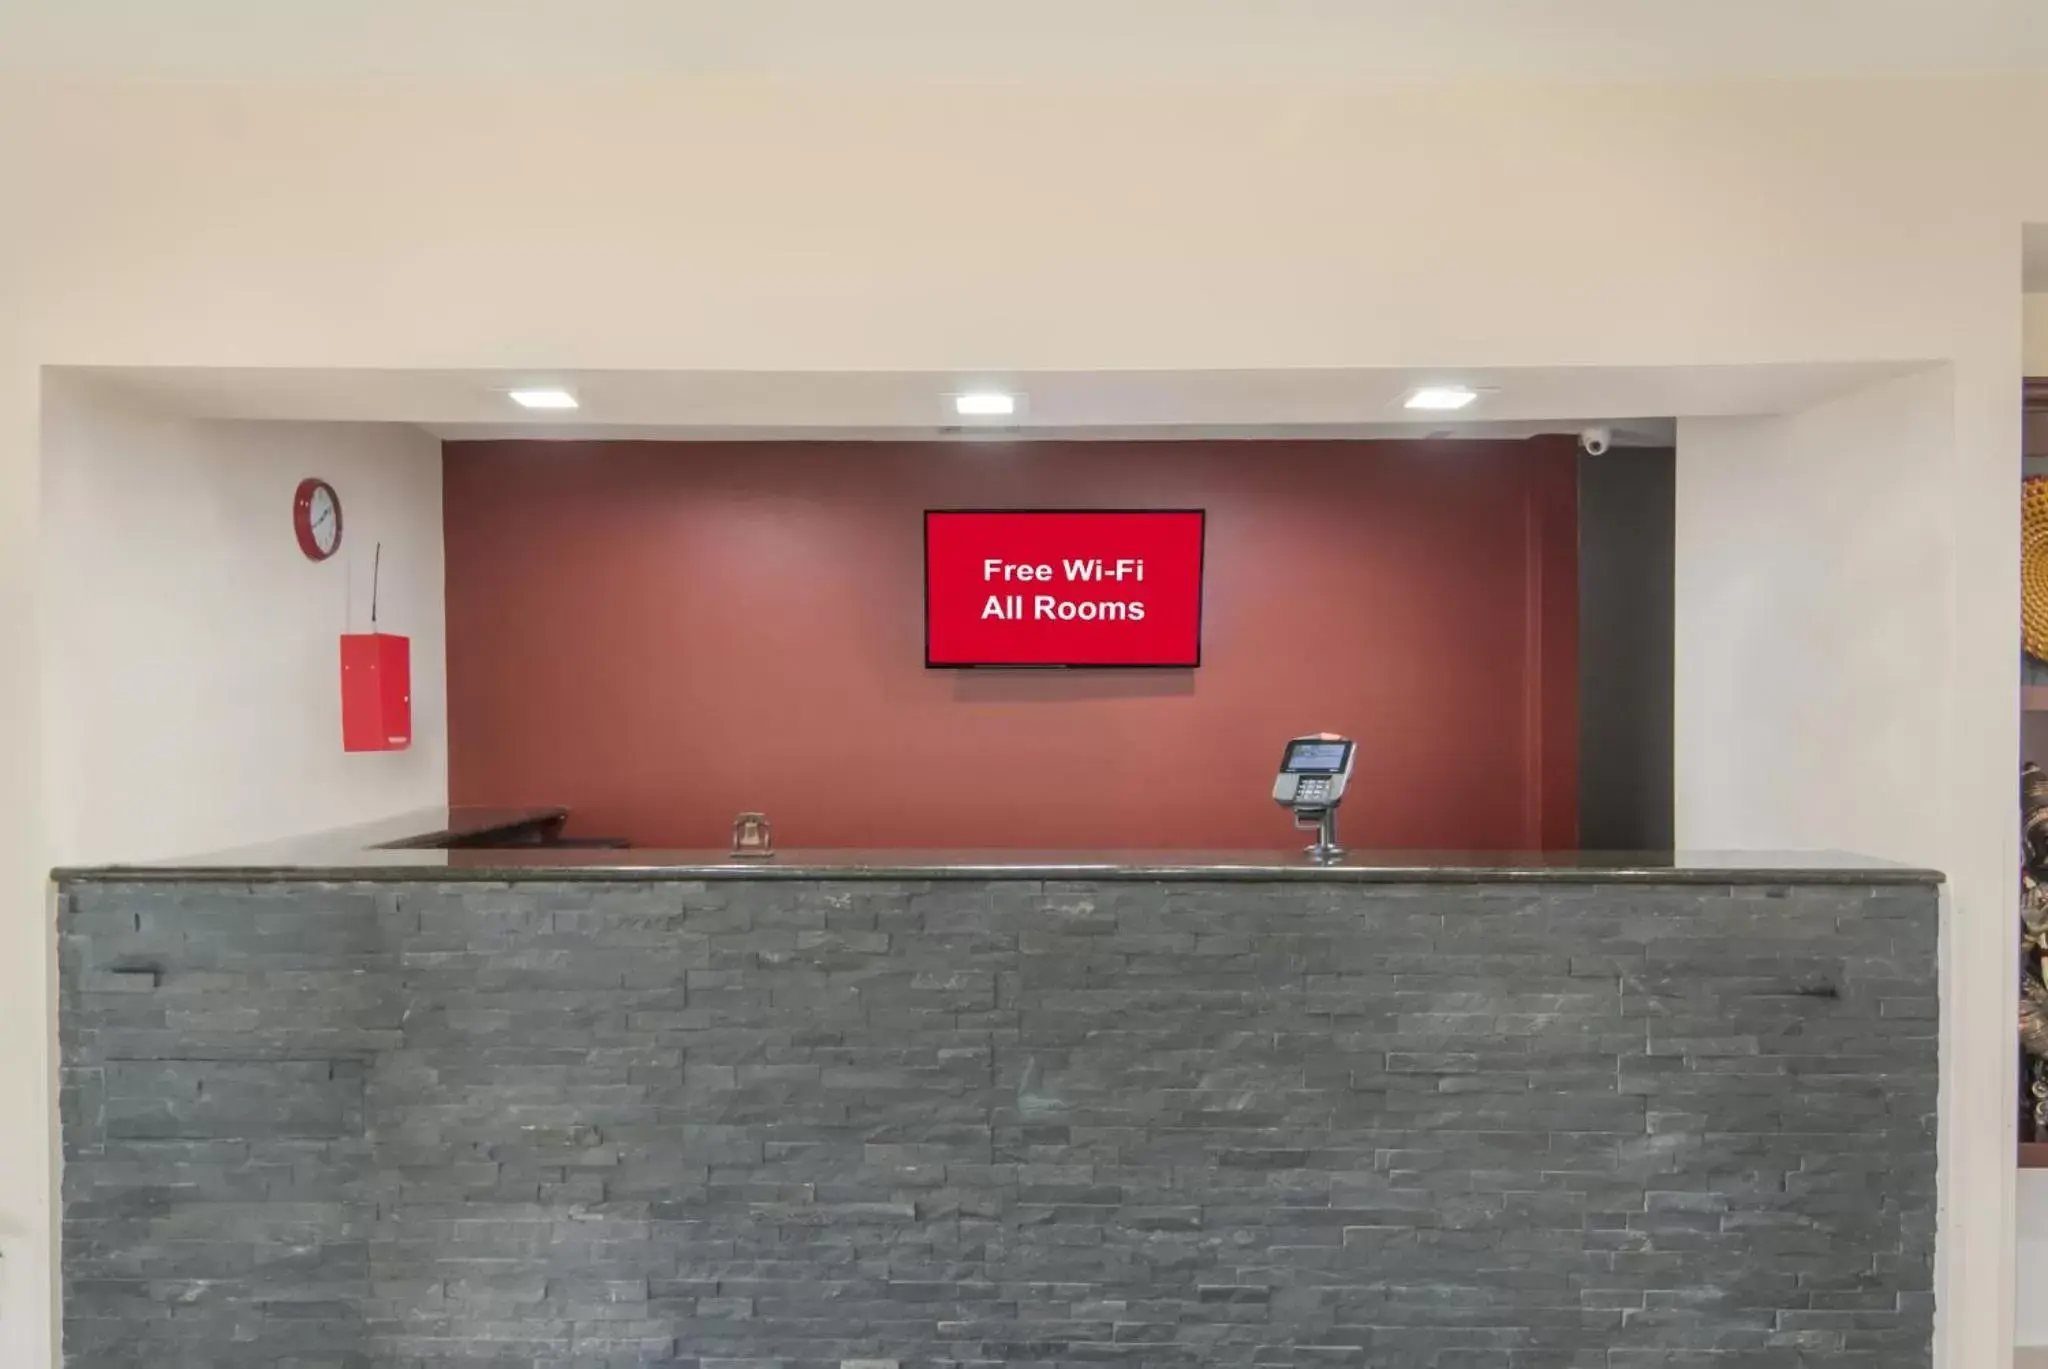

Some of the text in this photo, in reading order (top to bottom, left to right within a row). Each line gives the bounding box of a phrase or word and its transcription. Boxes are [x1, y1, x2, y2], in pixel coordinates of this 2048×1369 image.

[984, 559, 1144, 581] Free Wi-Fi
[981, 595, 1145, 620] All Rooms
